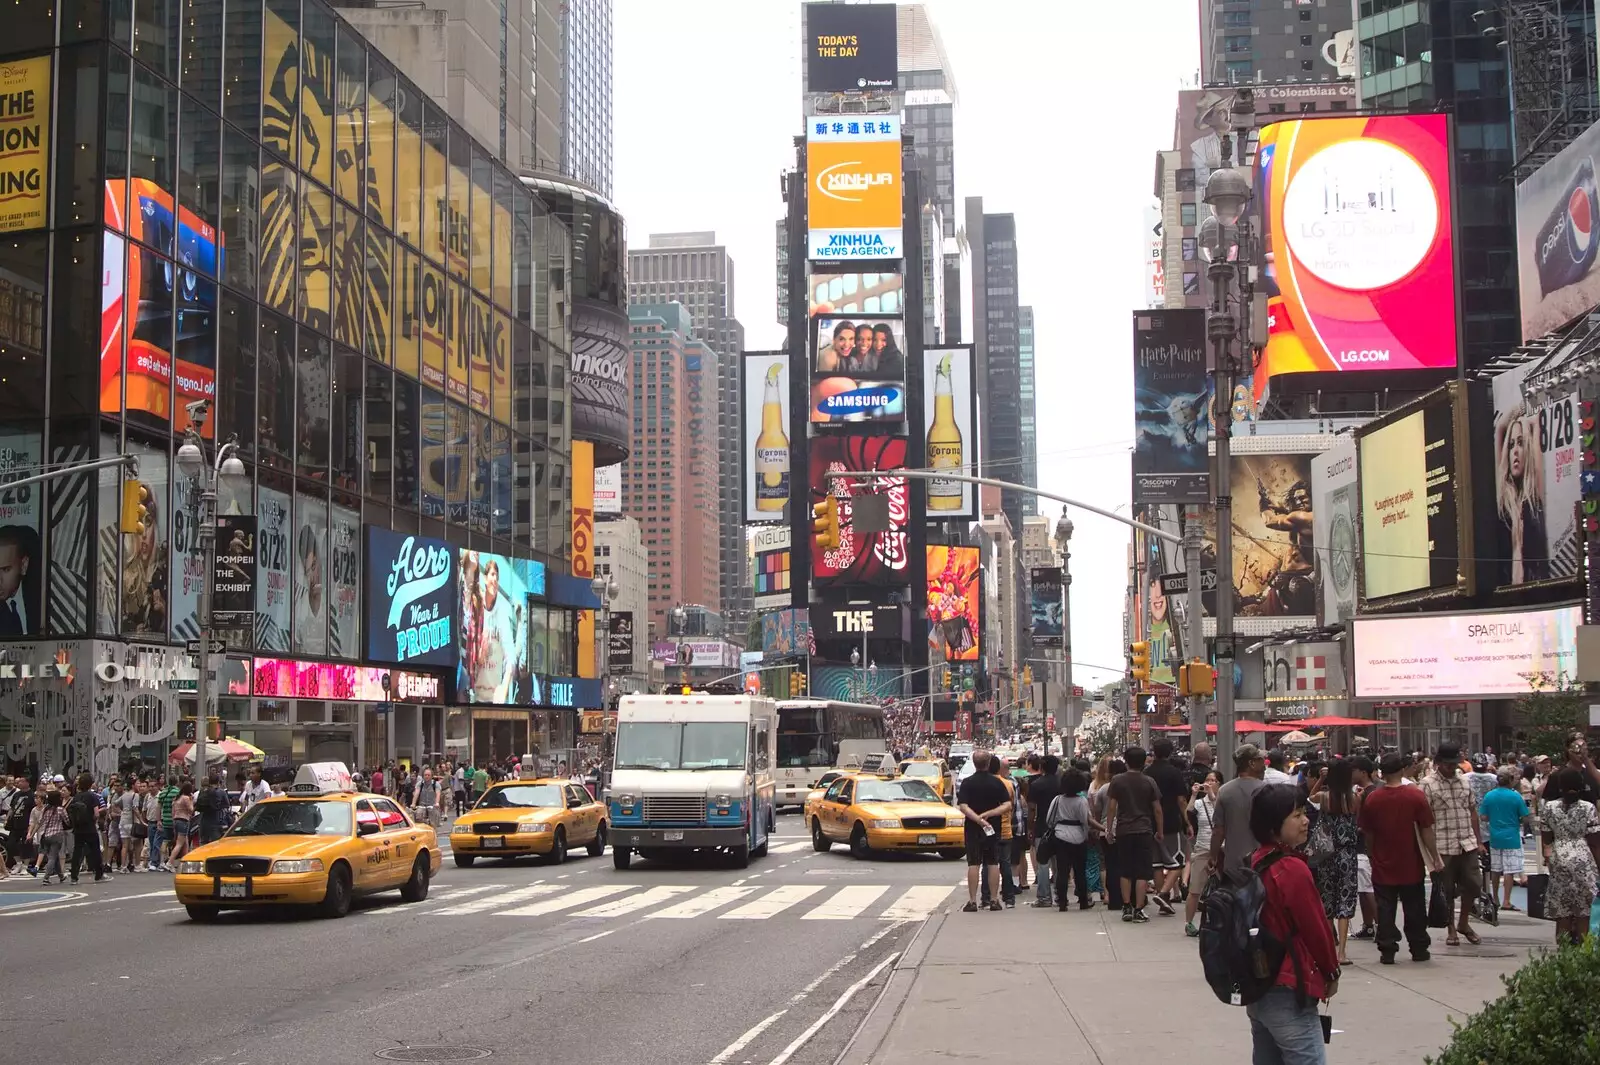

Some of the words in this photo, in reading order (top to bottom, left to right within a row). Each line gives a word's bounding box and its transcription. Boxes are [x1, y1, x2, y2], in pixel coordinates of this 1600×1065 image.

[817, 35, 858, 46] TODAY'S
[818, 47, 837, 57] THE
[839, 47, 859, 57] DAY
[1270, 87, 1336, 98] Colombian
[815, 122, 892, 135] 新华通讯社
[829, 234, 883, 247] XINHUA
[1542, 211, 1565, 264] pepsi
[816, 247, 848, 256] NEWS
[851, 246, 896, 256] AGENCY
[1341, 350, 1389, 363] LG.COM
[827, 394, 889, 407] SAMSUNG
[1538, 398, 1573, 453] 8/28
[758, 448, 788, 459] Corona
[928, 444, 961, 457] Corona
[216, 555, 254, 565] POMPEII
[387, 536, 450, 597] Aero
[216, 569, 234, 578] THE
[215, 583, 252, 592] EXHIBIT
[1169, 578, 1188, 589] ONE
[410, 605, 432, 626] Wear
[432, 602, 439, 618] it
[832, 610, 874, 632] THE
[1468, 622, 1525, 638] SPARITUAL
[397, 615, 450, 662] PROUD!
[171, 681, 179, 689] W
[180, 681, 188, 689] 44
[407, 676, 439, 698] ELEMENT
[1276, 704, 1310, 716] swatch
